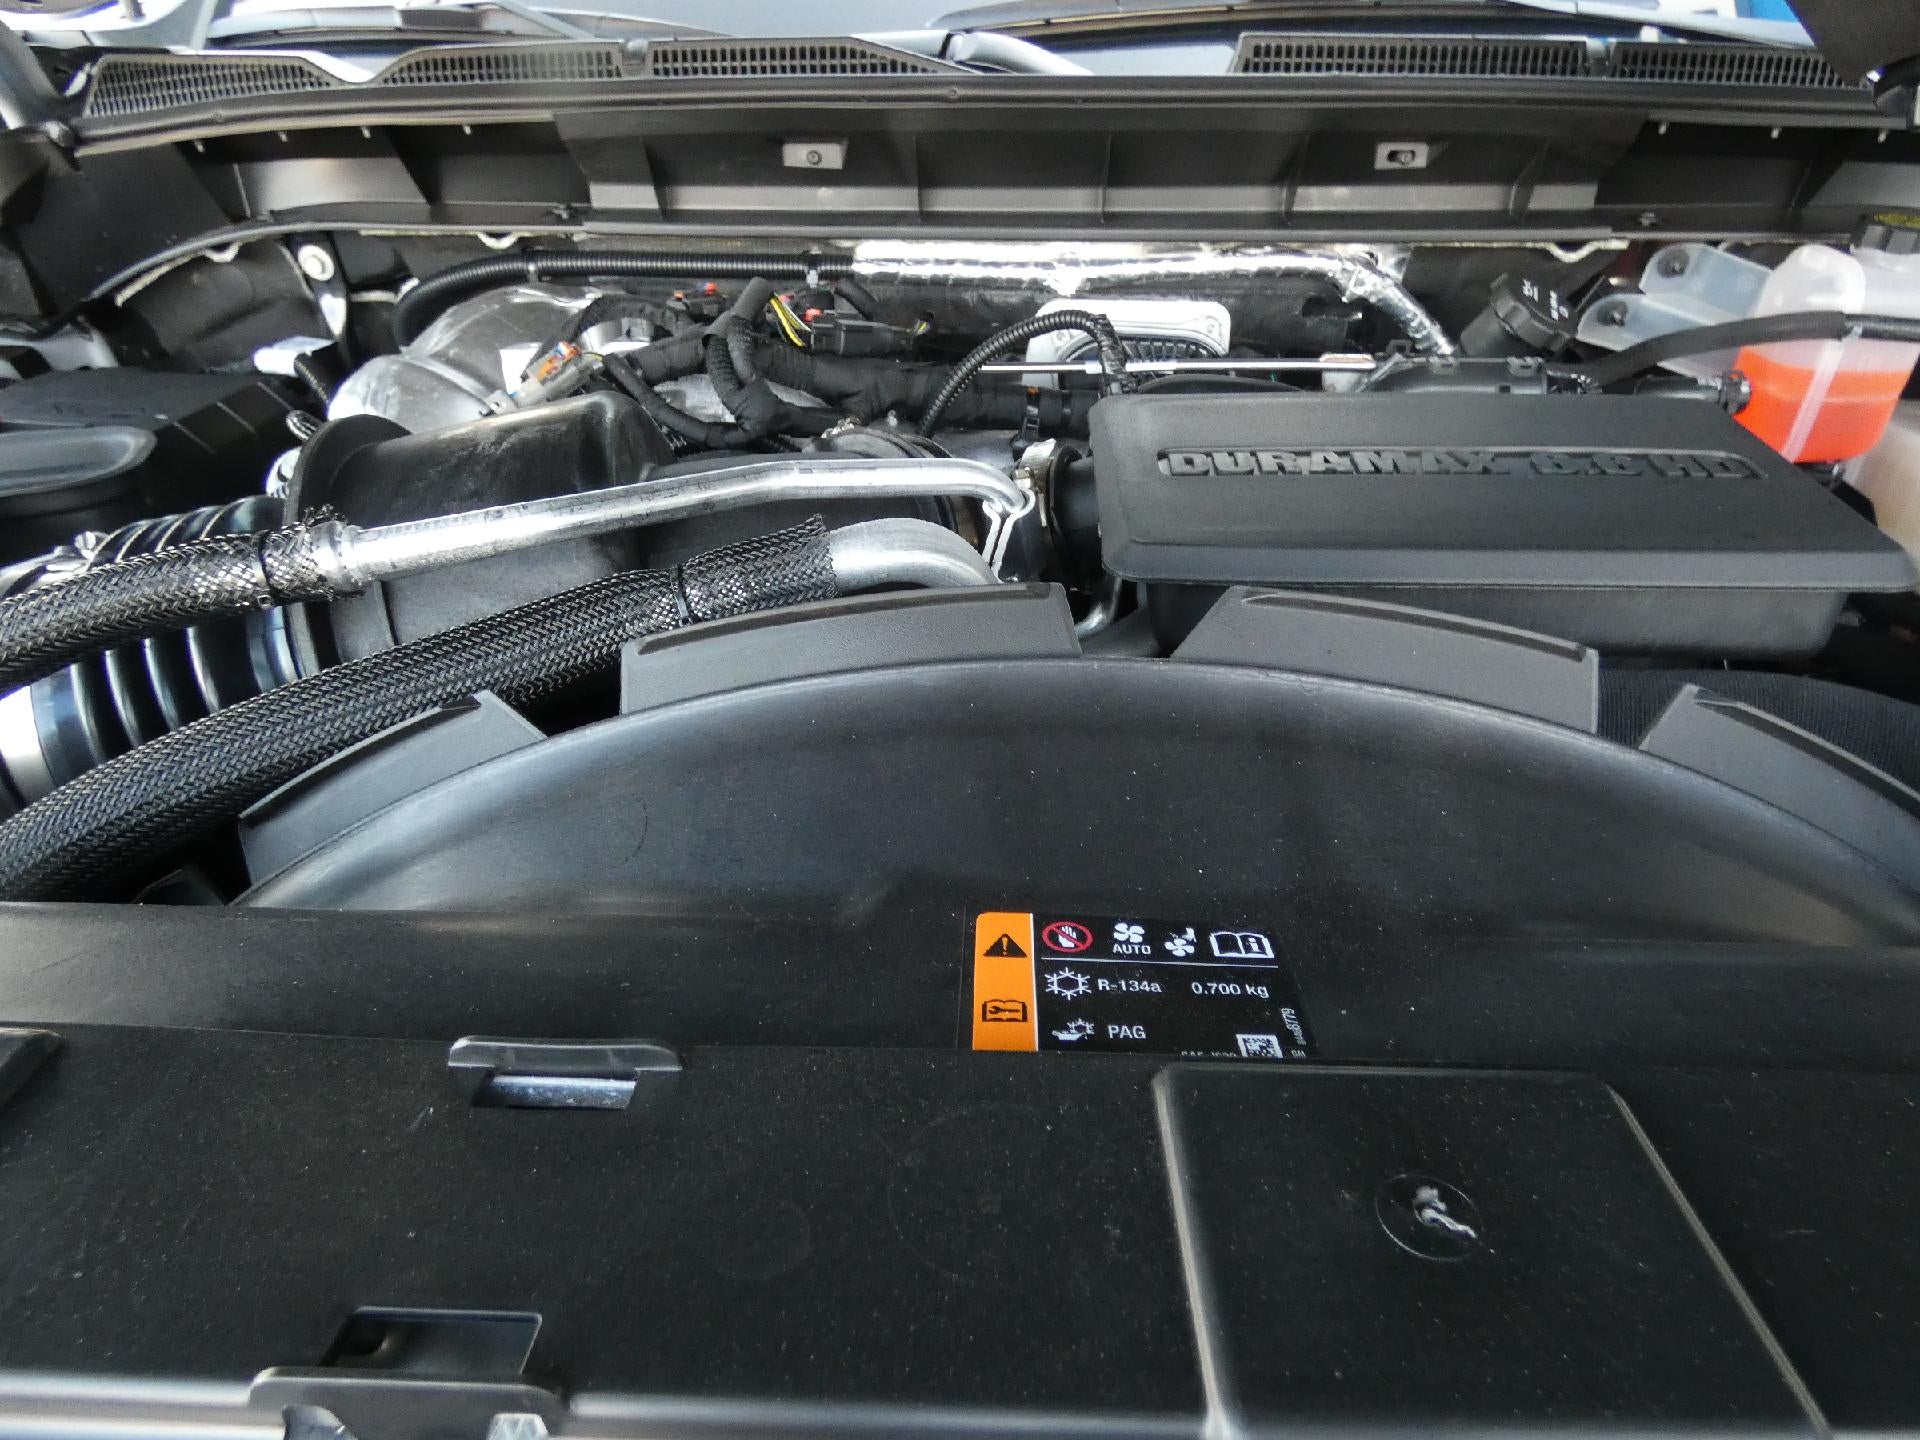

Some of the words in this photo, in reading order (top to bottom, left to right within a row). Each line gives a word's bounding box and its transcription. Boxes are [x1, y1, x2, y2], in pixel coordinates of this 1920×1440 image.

[1166, 450, 1507, 477] DURAMAX
[1648, 453, 1752, 479] HD
[1113, 944, 1151, 955] AUTO
[1098, 979, 1162, 993] R-134a
[1192, 982, 1240, 995] 0.700
[1247, 984, 1269, 998] kg
[1108, 1024, 1147, 1039] PAG
